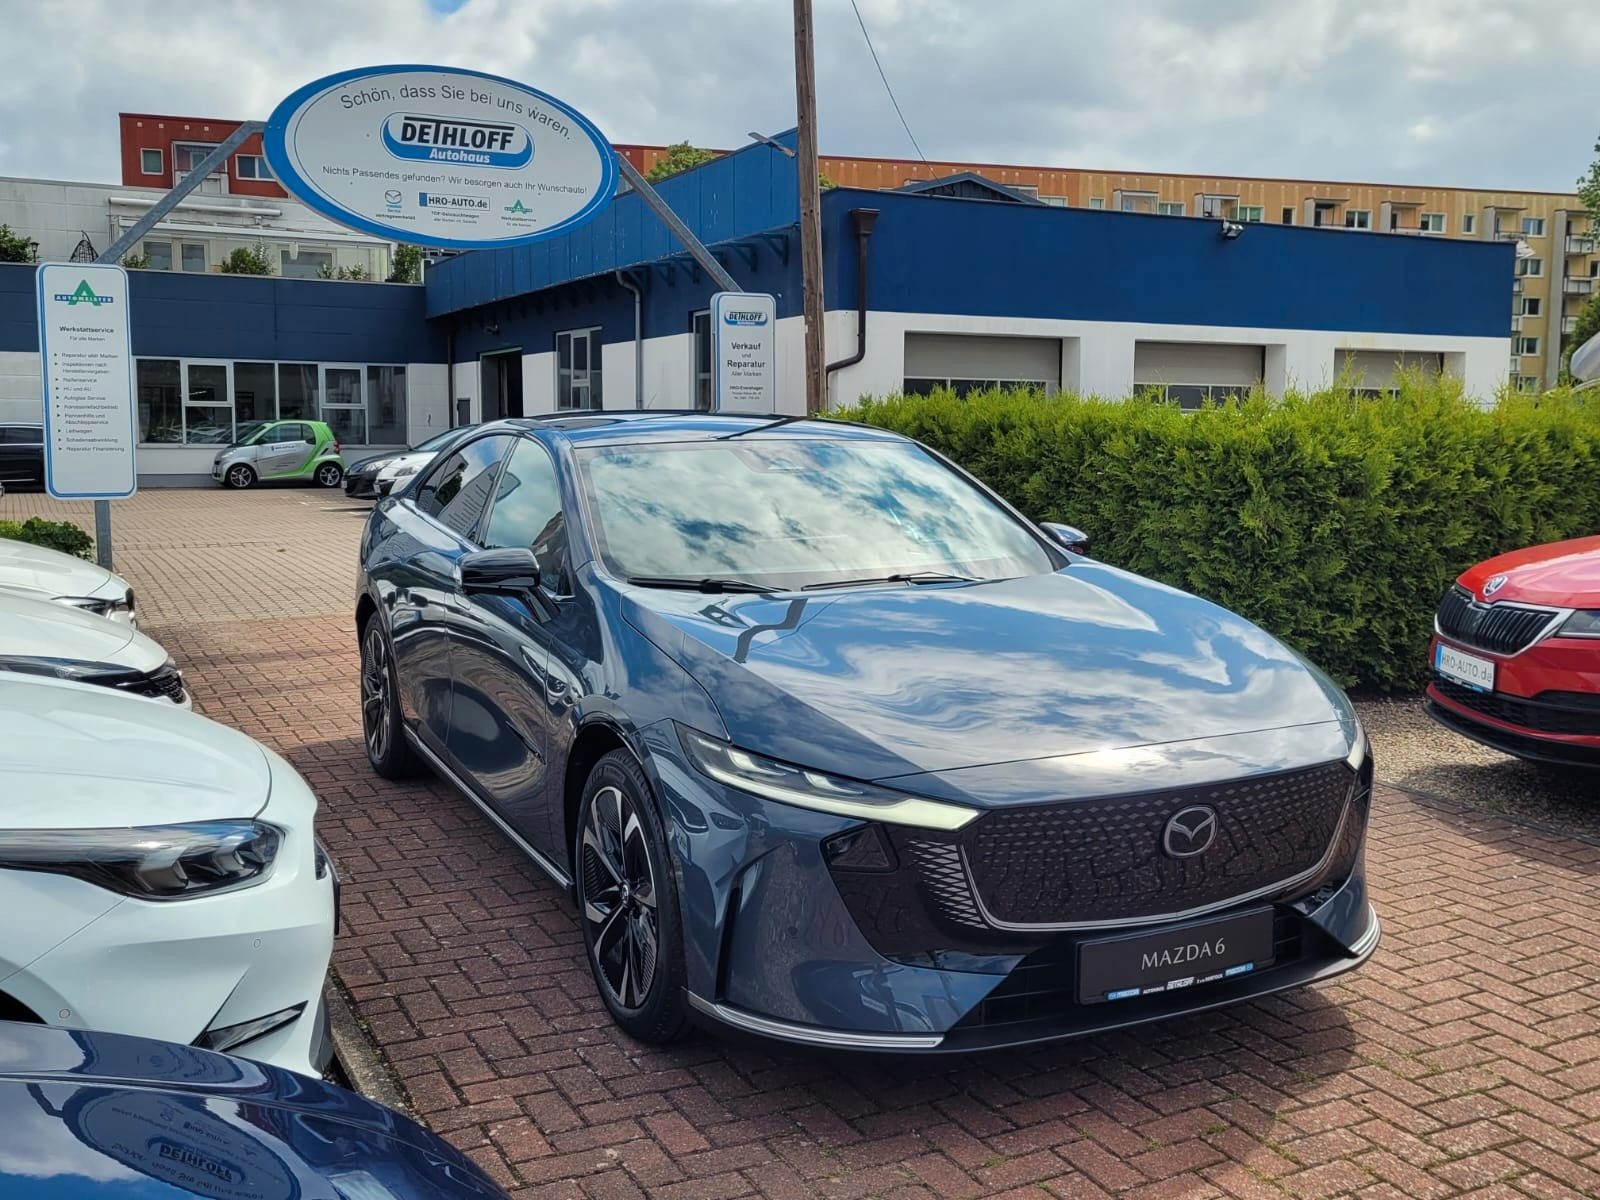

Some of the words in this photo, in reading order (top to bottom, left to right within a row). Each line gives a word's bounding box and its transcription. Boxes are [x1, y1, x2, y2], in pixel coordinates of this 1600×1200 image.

[341, 86, 396, 109] Schön,
[399, 84, 436, 99] dass
[441, 85, 465, 100] Sie
[470, 88, 492, 105] bei
[497, 98, 524, 114] uns
[527, 106, 572, 140] waren.
[401, 116, 515, 151] DETHLOFF
[429, 148, 491, 164] Autohaus
[322, 165, 350, 176] Nichts
[352, 167, 400, 180] Passendes
[402, 171, 446, 183] gefunden?
[448, 175, 462, 184] Wir
[464, 177, 502, 189] besorgen
[503, 180, 523, 189] auch
[525, 182, 536, 191] Ihr
[537, 183, 587, 194] Wunschauto!
[428, 196, 488, 209] HRO-AUTO.de
[55, 295, 113, 303] AUTOMEISTER
[729, 311, 763, 320] DETHLOFF
[59, 326, 115, 334] Werkstattservice
[731, 342, 762, 351] Verkauf
[727, 359, 766, 368] Reparatur
[1141, 942, 1212, 971] MAZDA
[1214, 937, 1226, 955] 6
